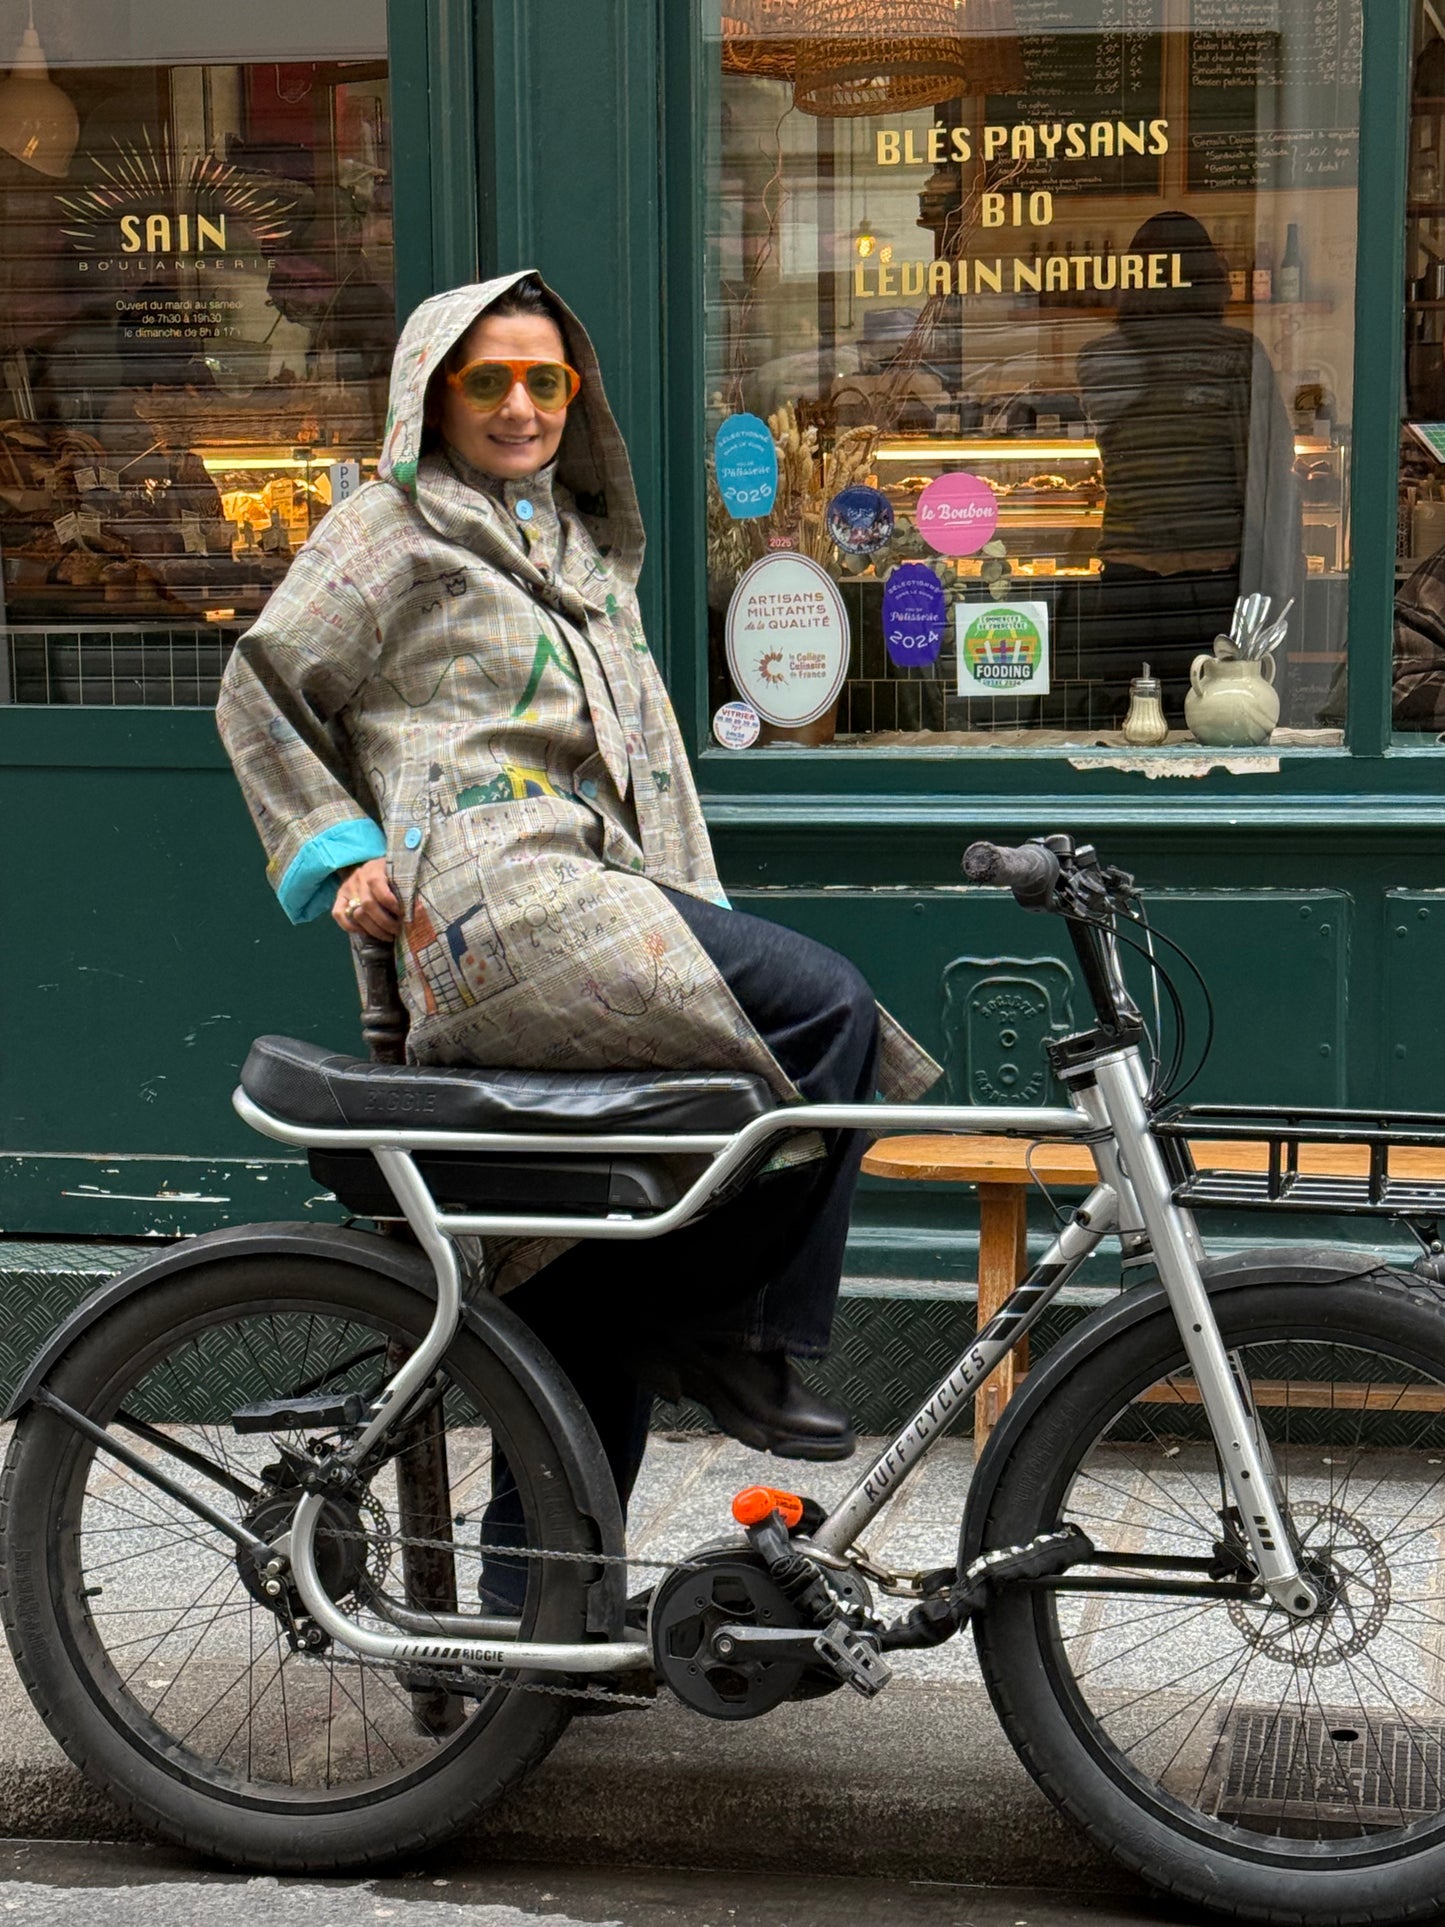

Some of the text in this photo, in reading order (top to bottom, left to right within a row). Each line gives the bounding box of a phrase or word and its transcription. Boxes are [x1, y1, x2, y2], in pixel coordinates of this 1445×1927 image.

[876, 119, 1169, 165] BLÉS PAYSANS
[981, 191, 1054, 227] BIO
[120, 213, 226, 253] SAIN
[1013, 253, 1192, 293] NATUREL
[115, 300, 242, 311] Ouvert du mardi au samed
[142, 312, 222, 324] de 7h30 à 19h30
[135, 327, 182, 338] dimanche
[184, 327, 198, 338] de
[724, 482, 772, 504] 2025
[921, 502, 996, 520] le Bonbon
[769, 538, 792, 548] 2025
[748, 592, 825, 606] ARTISANS
[748, 604, 827, 618] MILITANTS
[744, 616, 830, 631] de la QUALITÉ
[889, 630, 939, 648] 2024
[976, 664, 1031, 678] FOODING
[722, 708, 756, 721] VITRIER
[863, 1346, 987, 1504] RUFF CYCLES
[462, 1648, 505, 1663] BIGGIE
